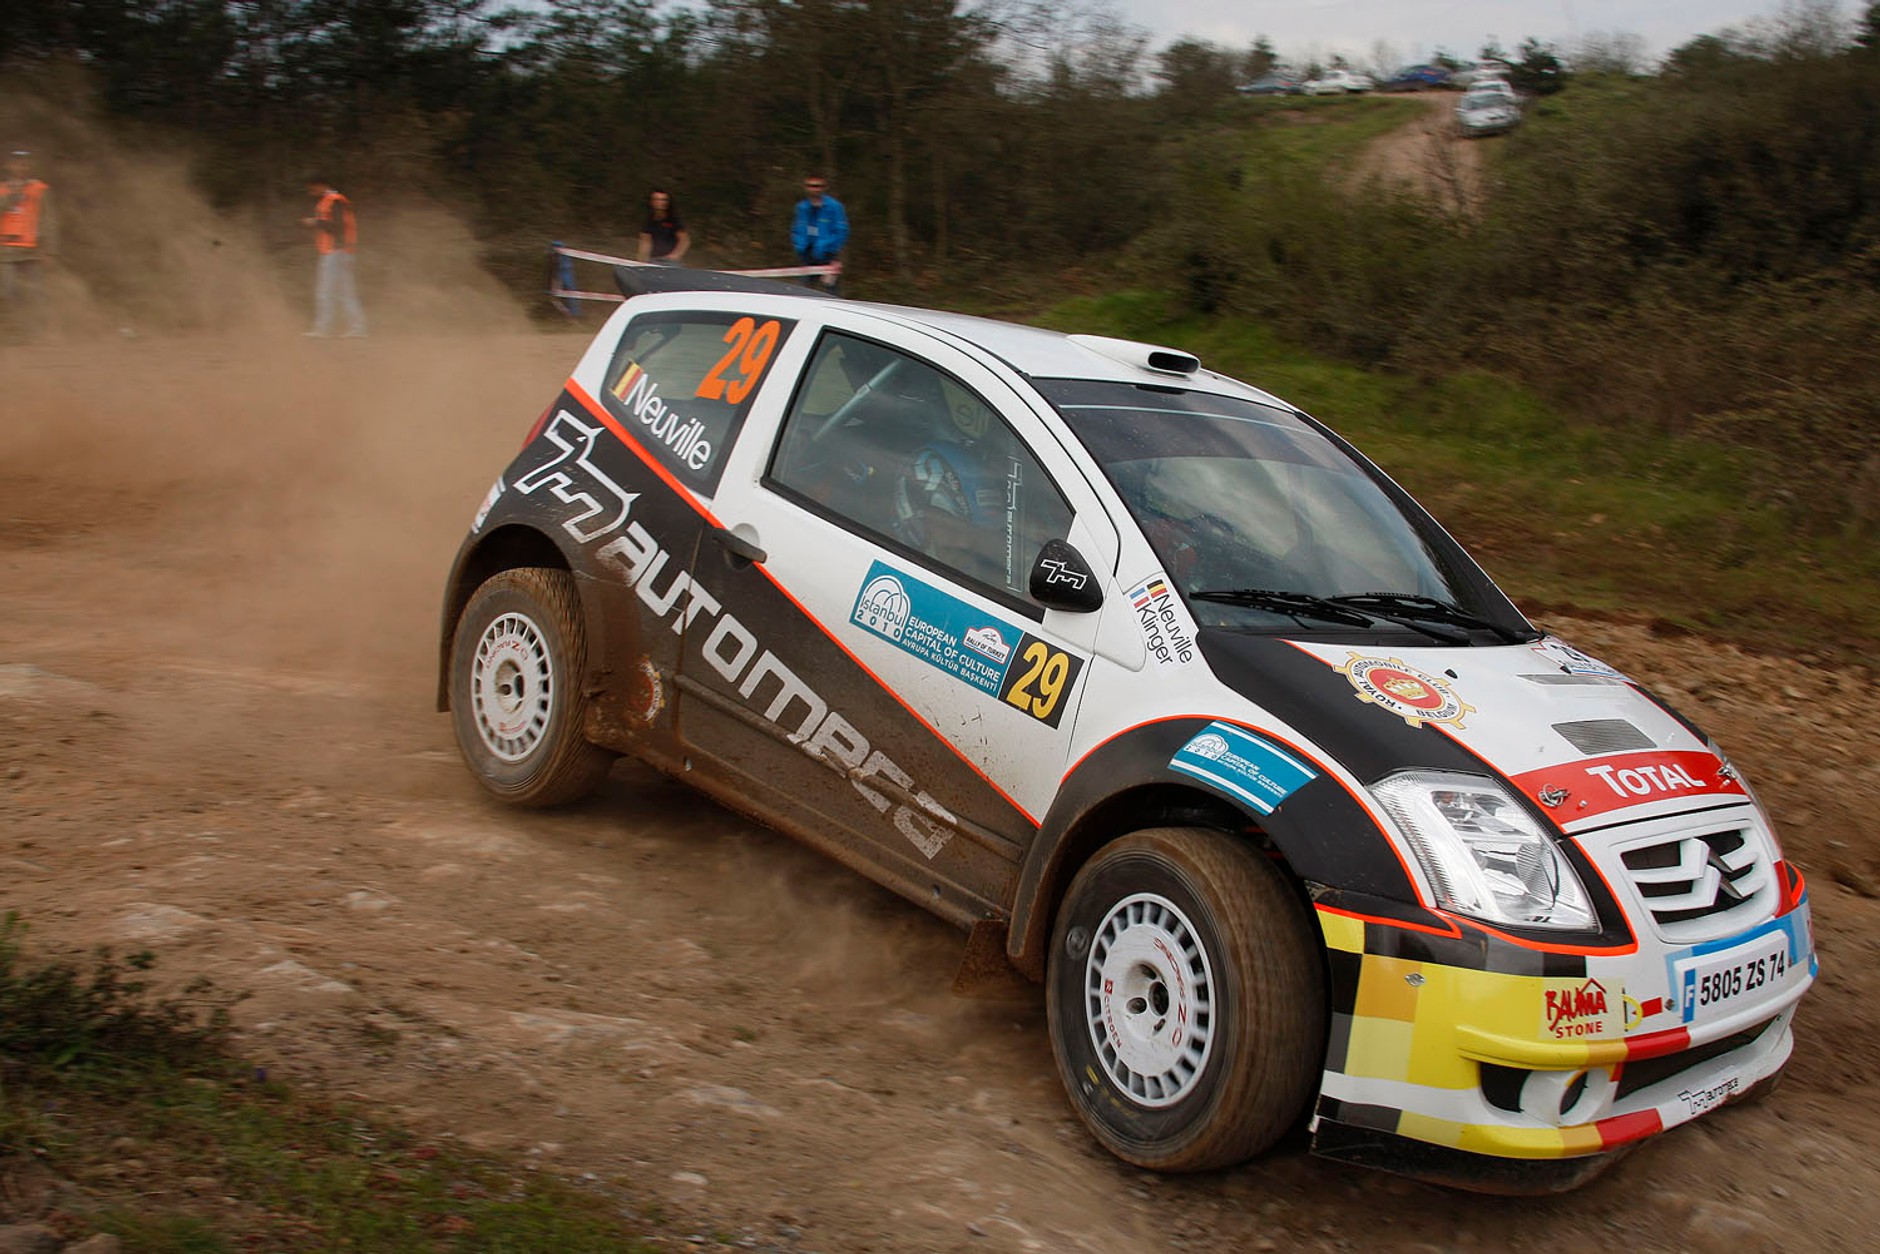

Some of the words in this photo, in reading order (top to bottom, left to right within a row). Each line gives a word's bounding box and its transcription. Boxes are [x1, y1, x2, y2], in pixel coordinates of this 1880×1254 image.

[695, 316, 782, 405] 29
[623, 373, 703, 470] Neuville
[908, 616, 958, 647] EUROPEAN
[966, 636, 981, 648] RALLY
[986, 646, 1005, 659] TURKEY
[1136, 602, 1173, 664] Klinger
[1153, 593, 1192, 663] Neuville
[902, 638, 929, 658] AVRUPA
[931, 651, 959, 672] KÜLTÜR
[905, 627, 942, 652] CAPITAL
[943, 646, 959, 659] OF
[959, 654, 1001, 683] CULTURE
[1006, 641, 1070, 719] 29
[1358, 680, 1397, 707] ROYAL
[1584, 764, 1708, 799] TOTAL
[1682, 983, 1697, 1009] F
[1699, 965, 1742, 1007] 5805
[1745, 957, 1766, 992] ZS
[1769, 949, 1785, 981] 74
[1555, 1020, 1603, 1039] STONE
